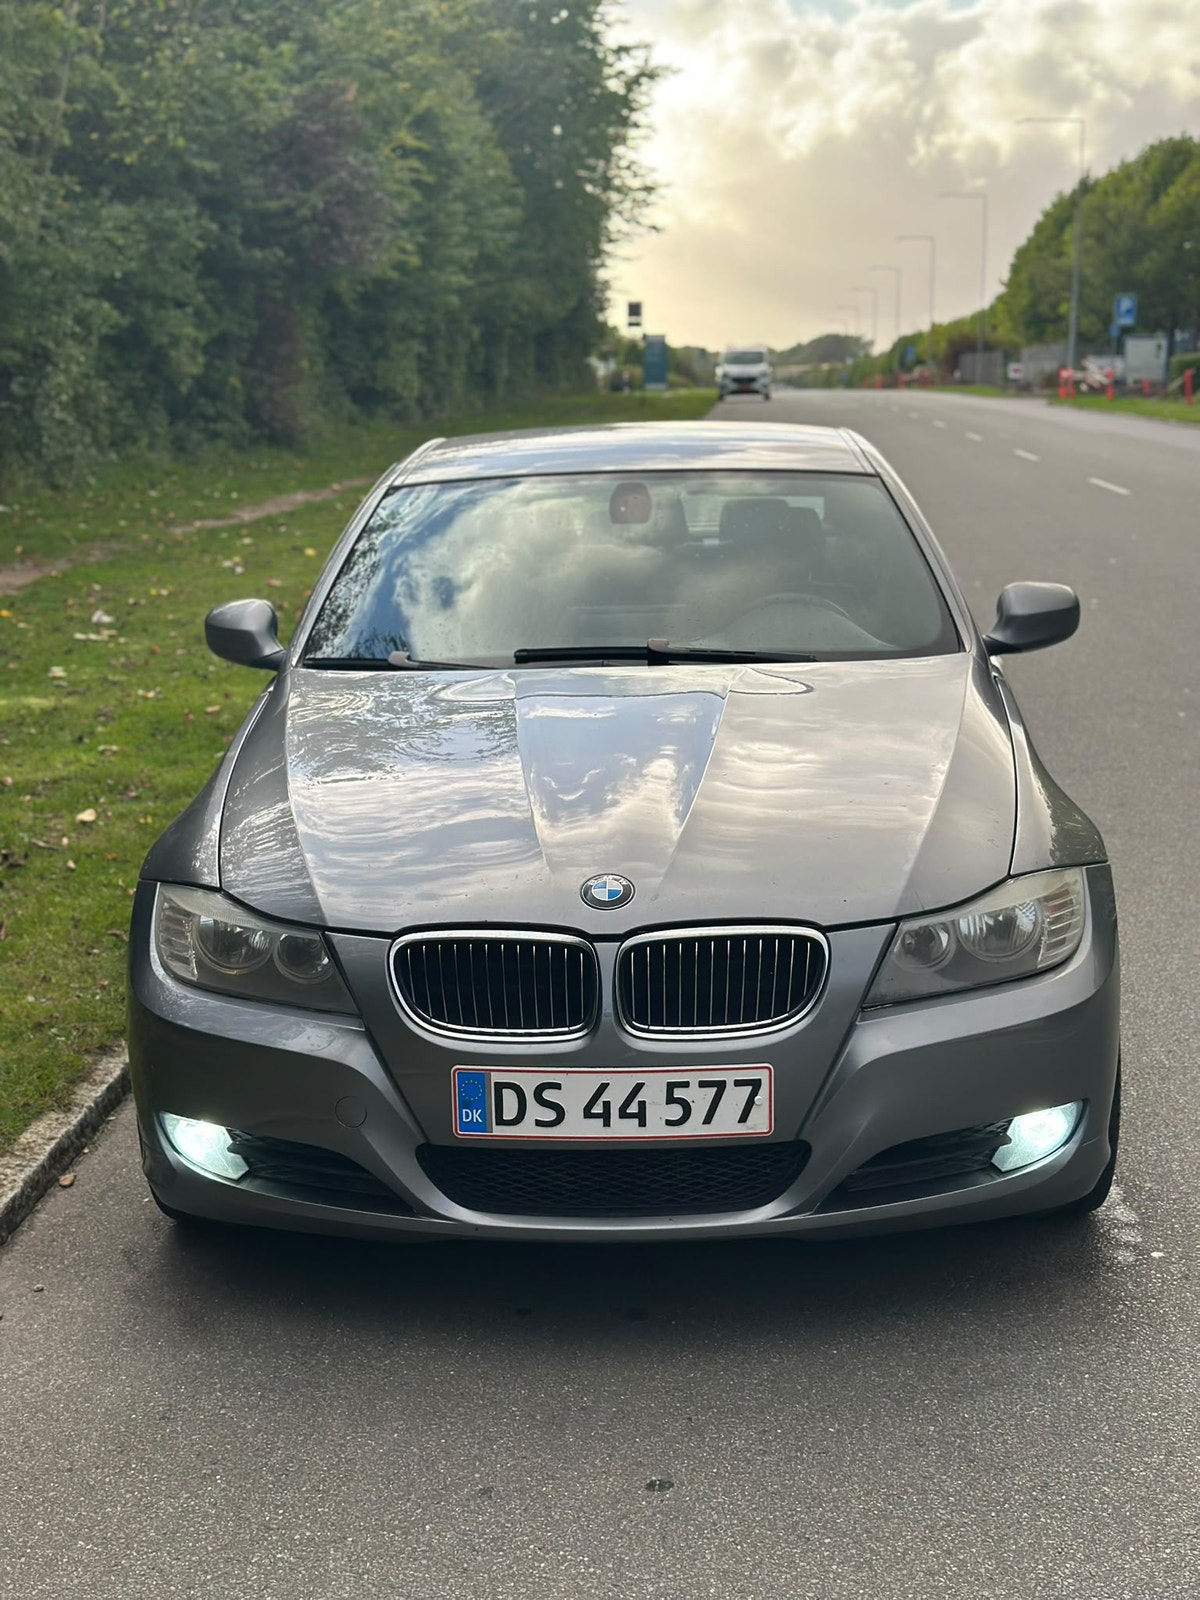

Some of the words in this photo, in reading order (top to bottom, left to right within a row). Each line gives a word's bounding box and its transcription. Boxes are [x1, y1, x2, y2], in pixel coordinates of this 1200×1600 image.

[462, 1108, 483, 1123] DK
[493, 1081, 566, 1128] DS
[583, 1082, 647, 1128] 44
[664, 1078, 763, 1127] 577
